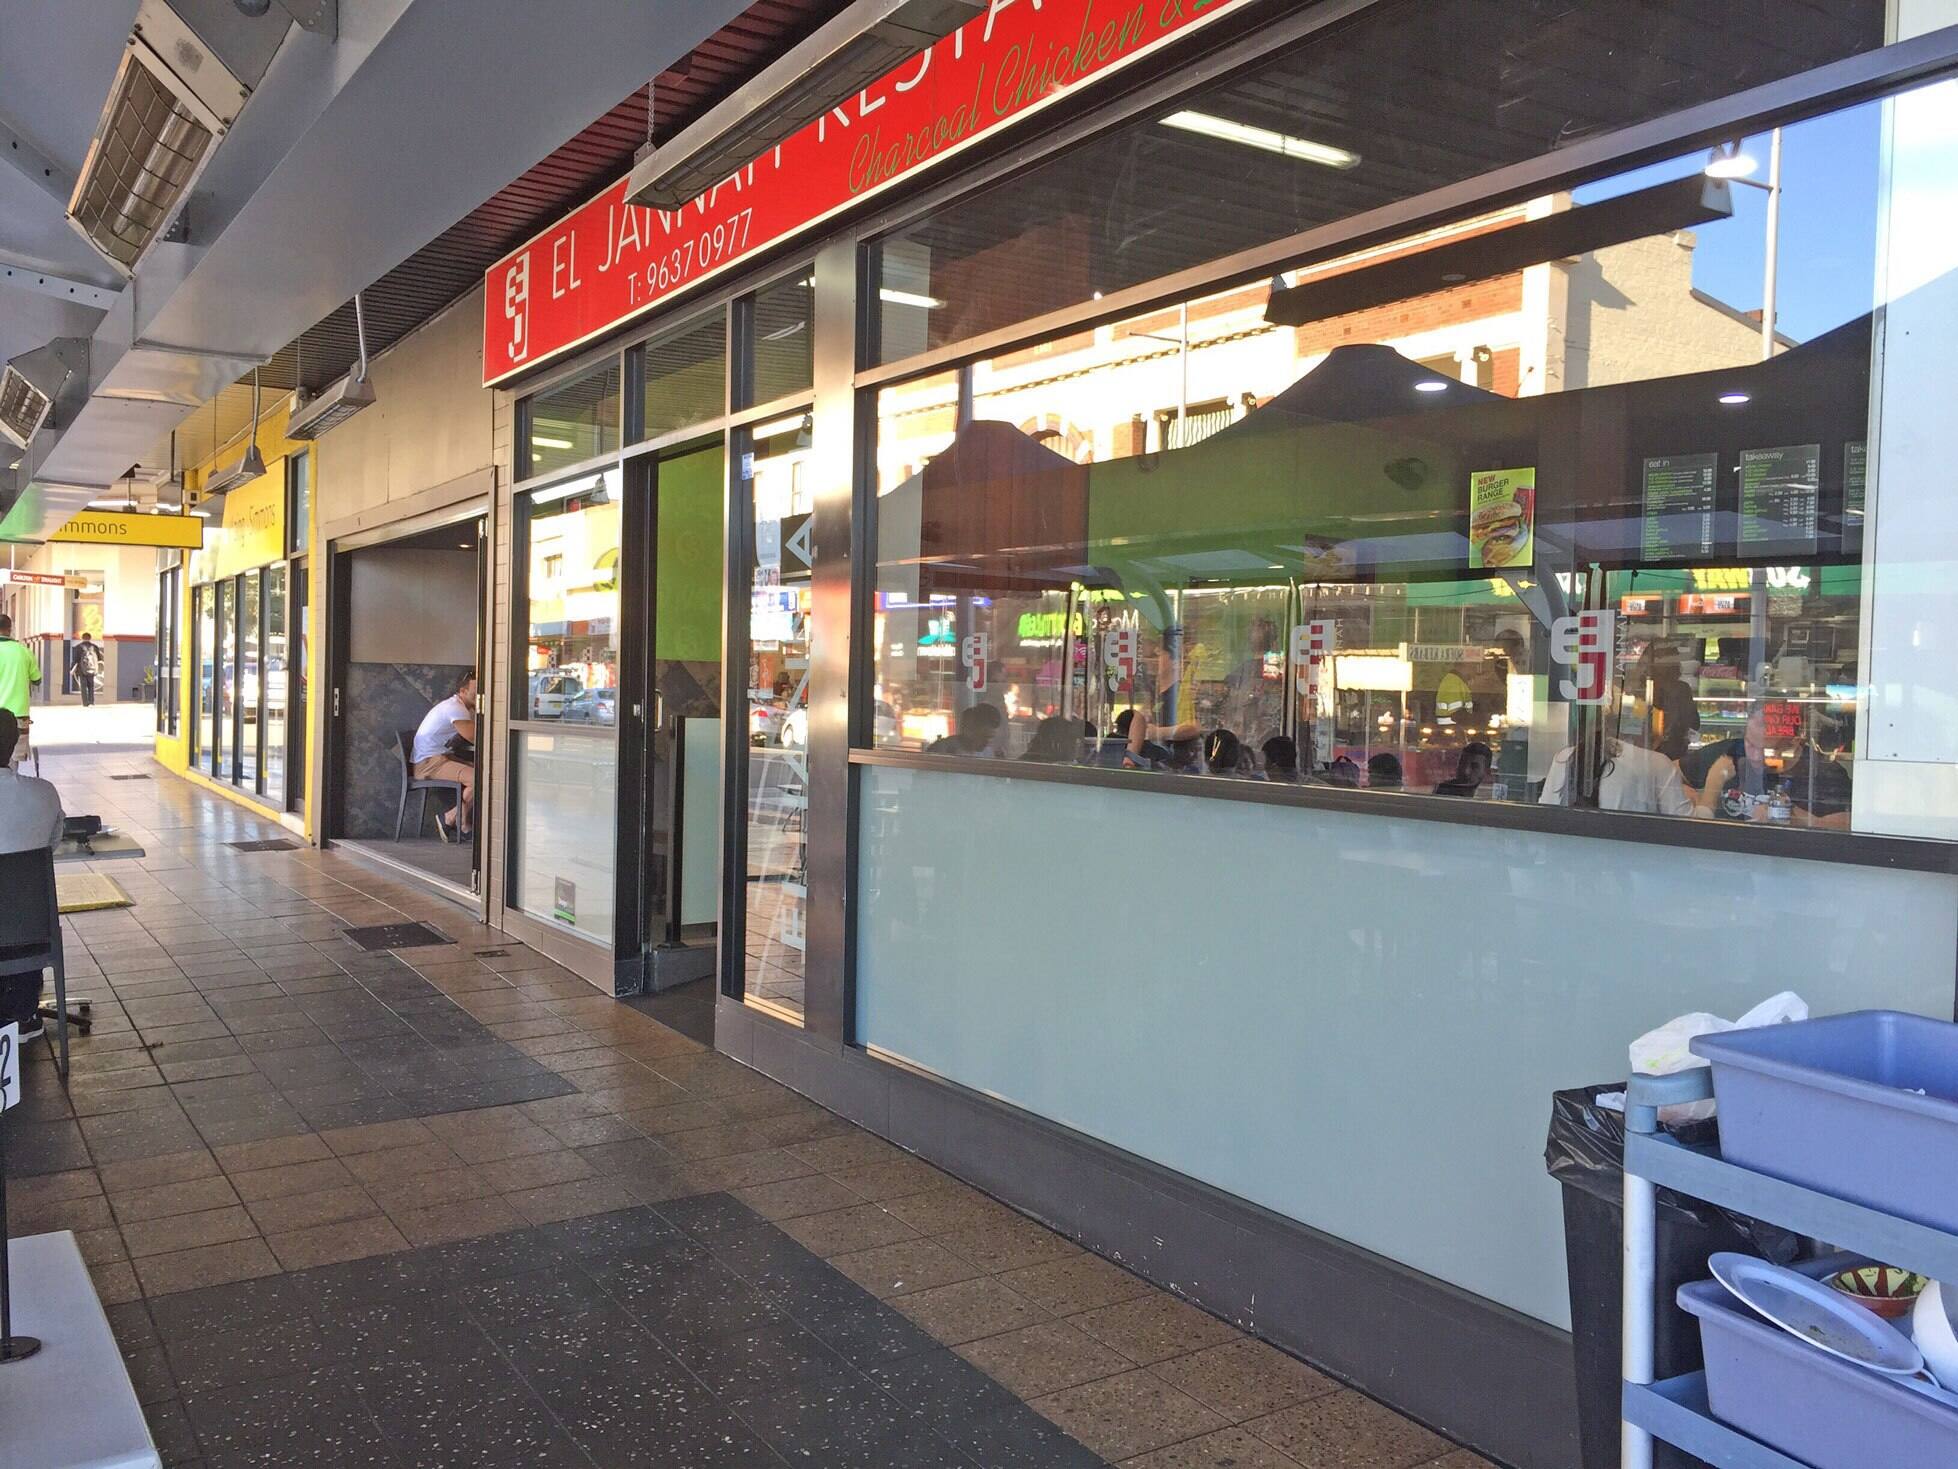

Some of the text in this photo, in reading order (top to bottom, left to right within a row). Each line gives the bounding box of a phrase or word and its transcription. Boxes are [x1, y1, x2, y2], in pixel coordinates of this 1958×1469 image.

[847, 63, 984, 194] Charcoal
[992, 0, 1147, 116] Chicken
[552, 230, 581, 300] EL
[1477, 478, 1509, 494] BURGER
[1478, 474, 1496, 486] NEW
[1477, 487, 1504, 503] RANGE
